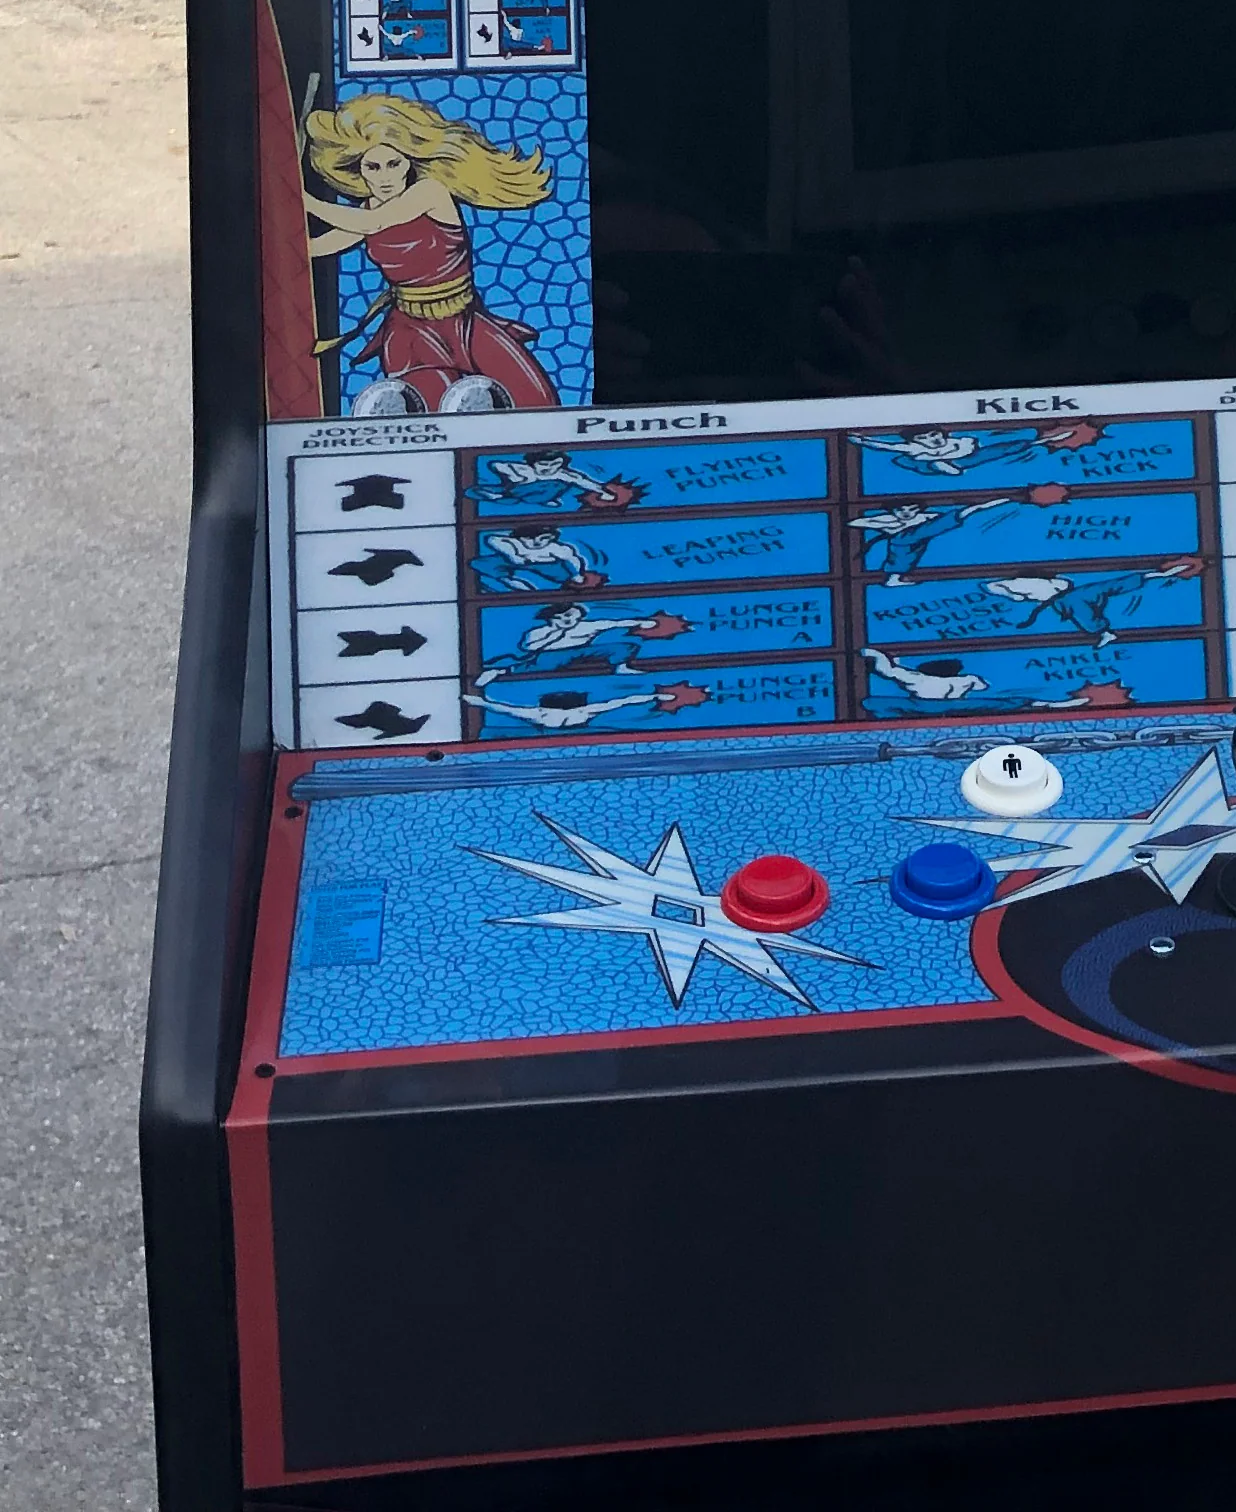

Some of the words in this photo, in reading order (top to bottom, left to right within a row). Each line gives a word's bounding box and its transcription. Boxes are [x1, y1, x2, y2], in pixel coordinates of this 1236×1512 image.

[975, 395, 1080, 415] Kick
[309, 424, 441, 438] JOYSTICK
[576, 412, 728, 435] Punch
[302, 433, 448, 450] DIRECTION
[1060, 444, 1173, 466] FLYING
[665, 451, 783, 481] FLYING
[1082, 459, 1158, 477] KICK
[674, 464, 789, 493] PUNCH
[1051, 514, 1132, 526] HIGH
[642, 525, 785, 560] LEAPING
[1045, 527, 1122, 541] KICK
[672, 539, 785, 569] PUNCH
[707, 600, 821, 618] LUNGE
[872, 591, 988, 622] ROUND
[901, 601, 1012, 630] HOUSE
[708, 614, 823, 631] PUNCH
[935, 616, 1014, 641] KICK
[1024, 648, 1133, 670] ANKLE
[715, 673, 830, 691] LUNGE
[1043, 661, 1121, 682] KICK
[715, 687, 833, 705] PUNCH
